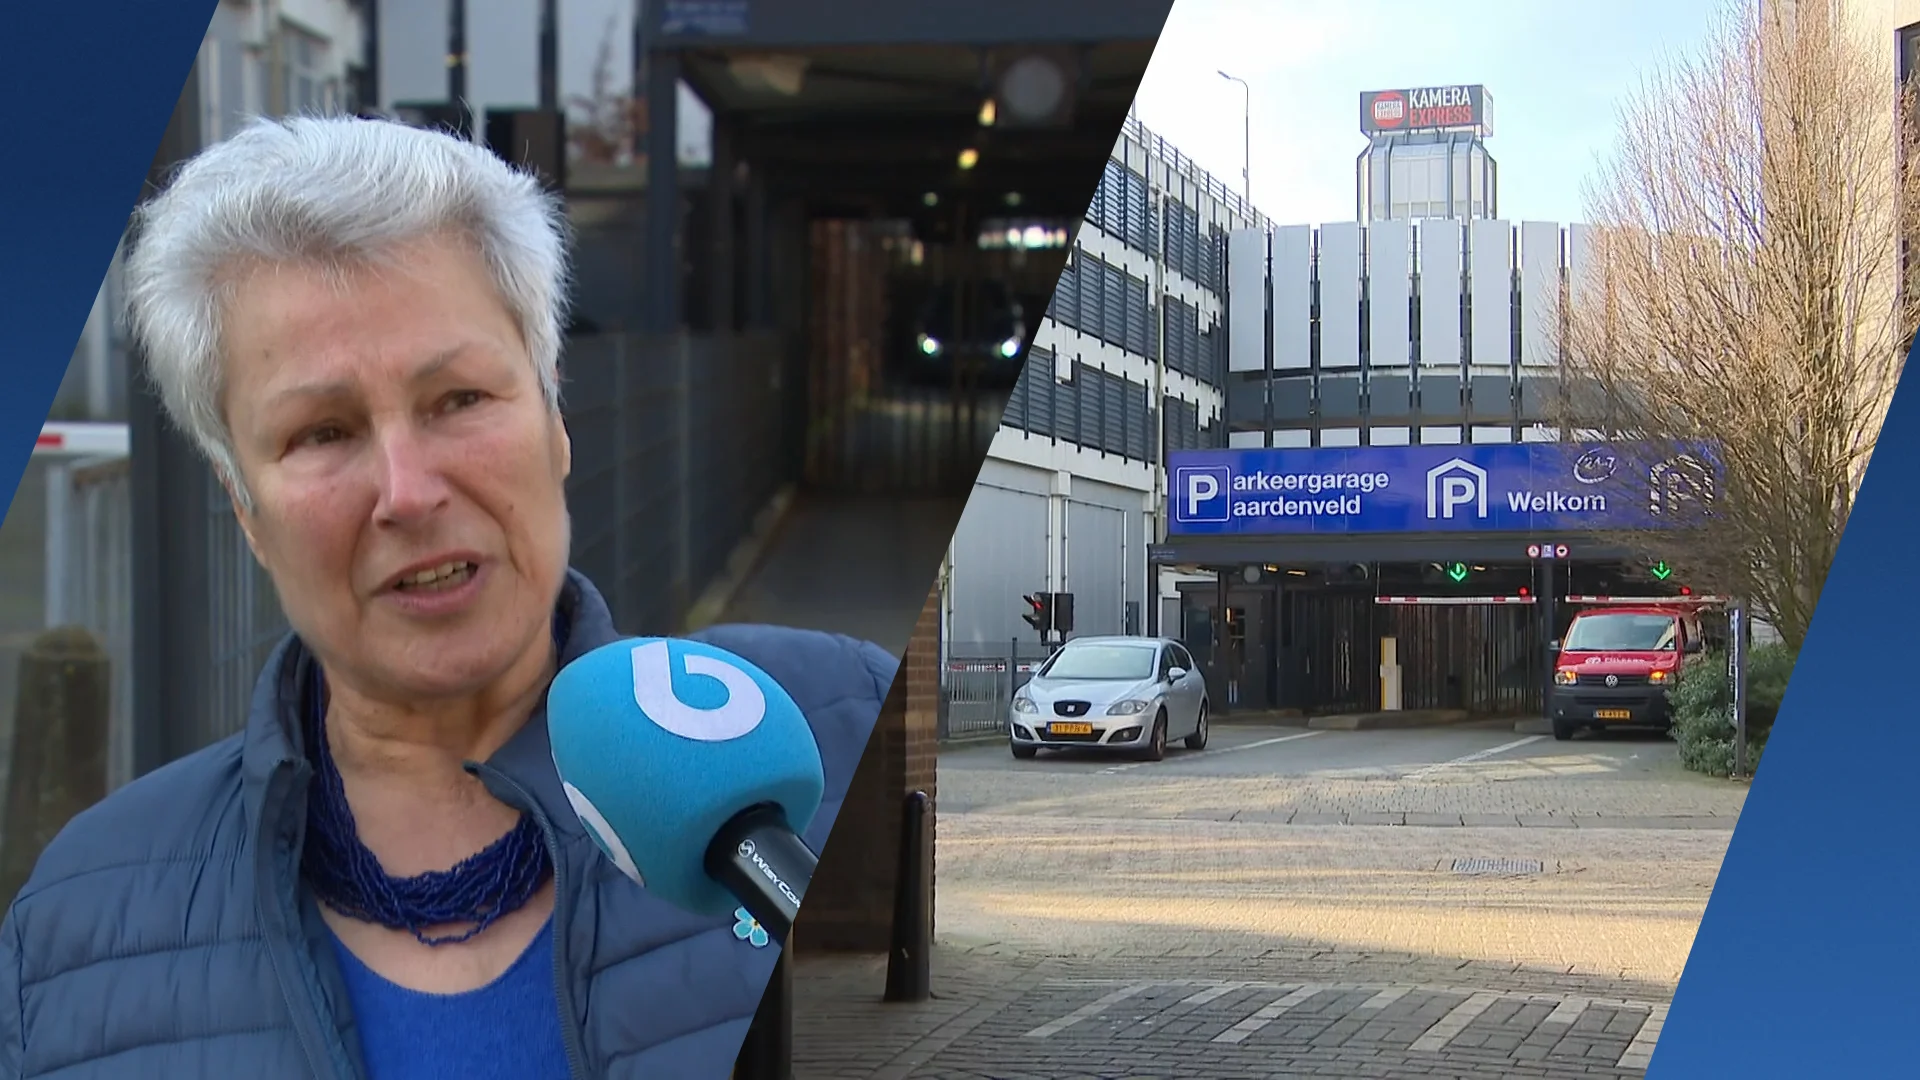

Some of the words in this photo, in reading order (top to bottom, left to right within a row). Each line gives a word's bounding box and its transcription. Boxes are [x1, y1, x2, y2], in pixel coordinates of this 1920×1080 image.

[1409, 87, 1472, 109] KAMERA
[1409, 106, 1473, 126] EXPRESS
[1188, 474, 1219, 516] P
[1233, 471, 1390, 493] arkeergarage
[1507, 491, 1606, 513] Welkom
[1233, 495, 1361, 516] aardenveld
